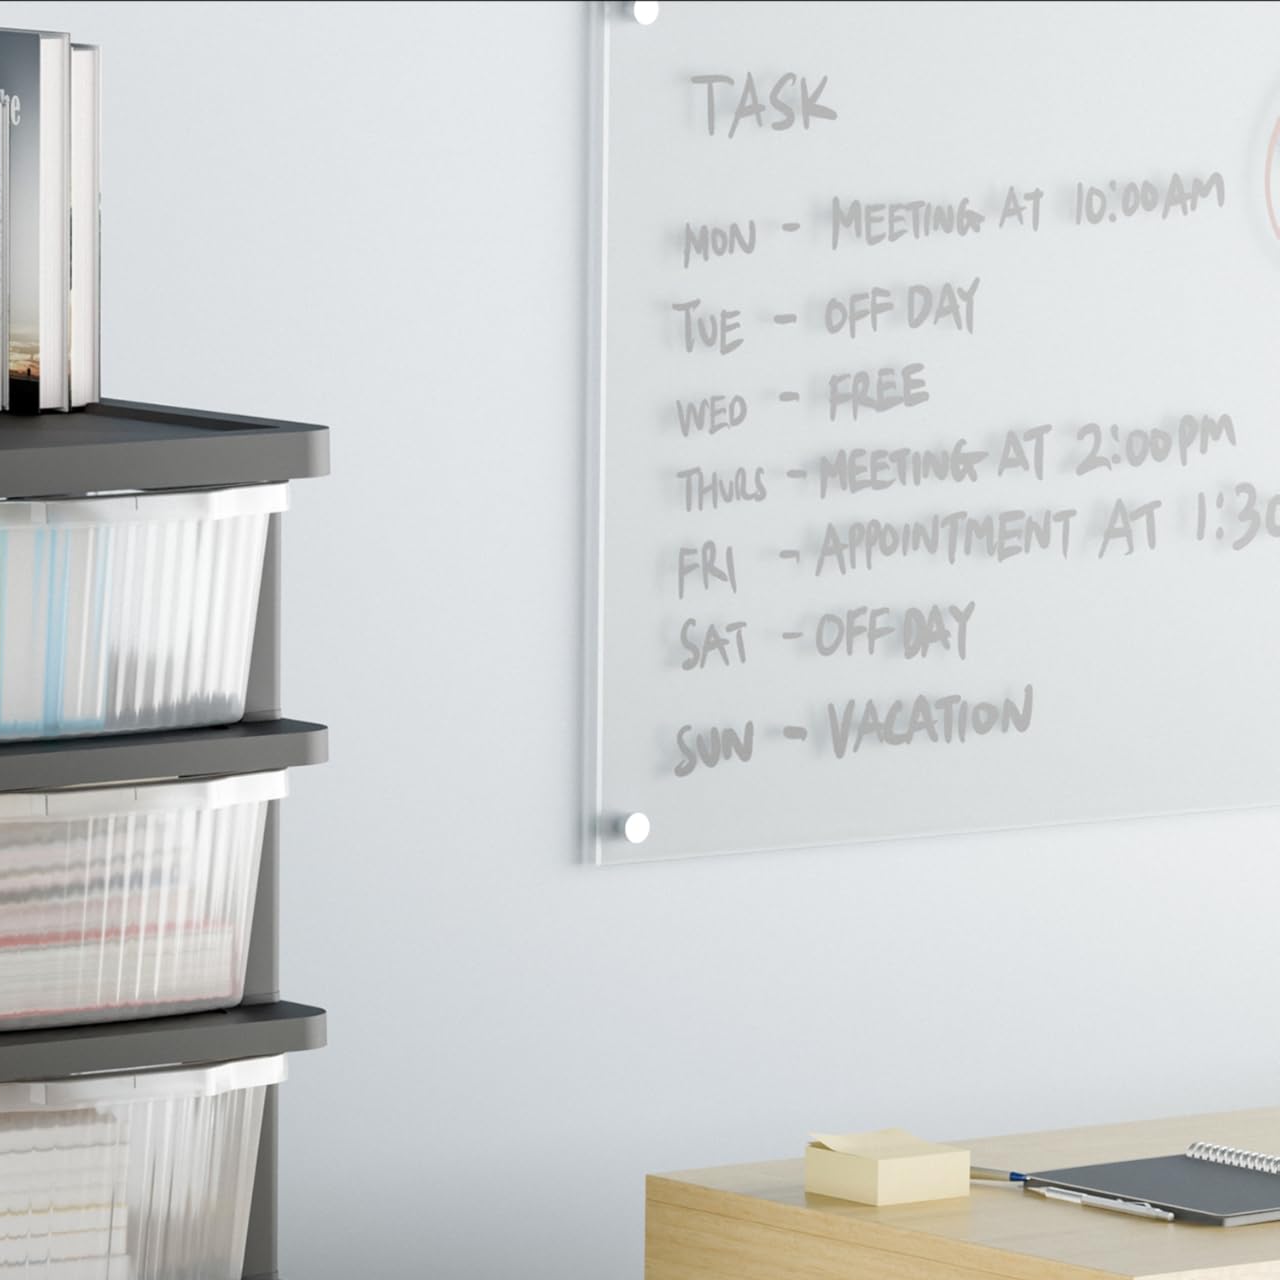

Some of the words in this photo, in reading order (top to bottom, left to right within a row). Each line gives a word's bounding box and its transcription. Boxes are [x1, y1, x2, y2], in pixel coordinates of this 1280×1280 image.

[690, 71, 838, 139] TASK
[683, 219, 756, 269] MON
[832, 195, 986, 251] MEETING
[998, 185, 1044, 233] AT
[671, 298, 745, 356] TUE
[824, 286, 895, 340] OFF
[907, 276, 981, 335] DAY
[676, 394, 748, 438] WED
[828, 362, 930, 422] FREE
[676, 466, 768, 513] THURS
[820, 438, 990, 500] MEETING
[997, 423, 1053, 482] AT
[677, 539, 738, 601] FRI
[815, 508, 1078, 577] APPOINTMENT
[1097, 496, 1163, 560] AT
[679, 617, 748, 672] SAT
[815, 604, 896, 657] OFF
[903, 600, 976, 661] DAY
[673, 720, 755, 778] SUN
[827, 683, 1034, 760] VACATION
